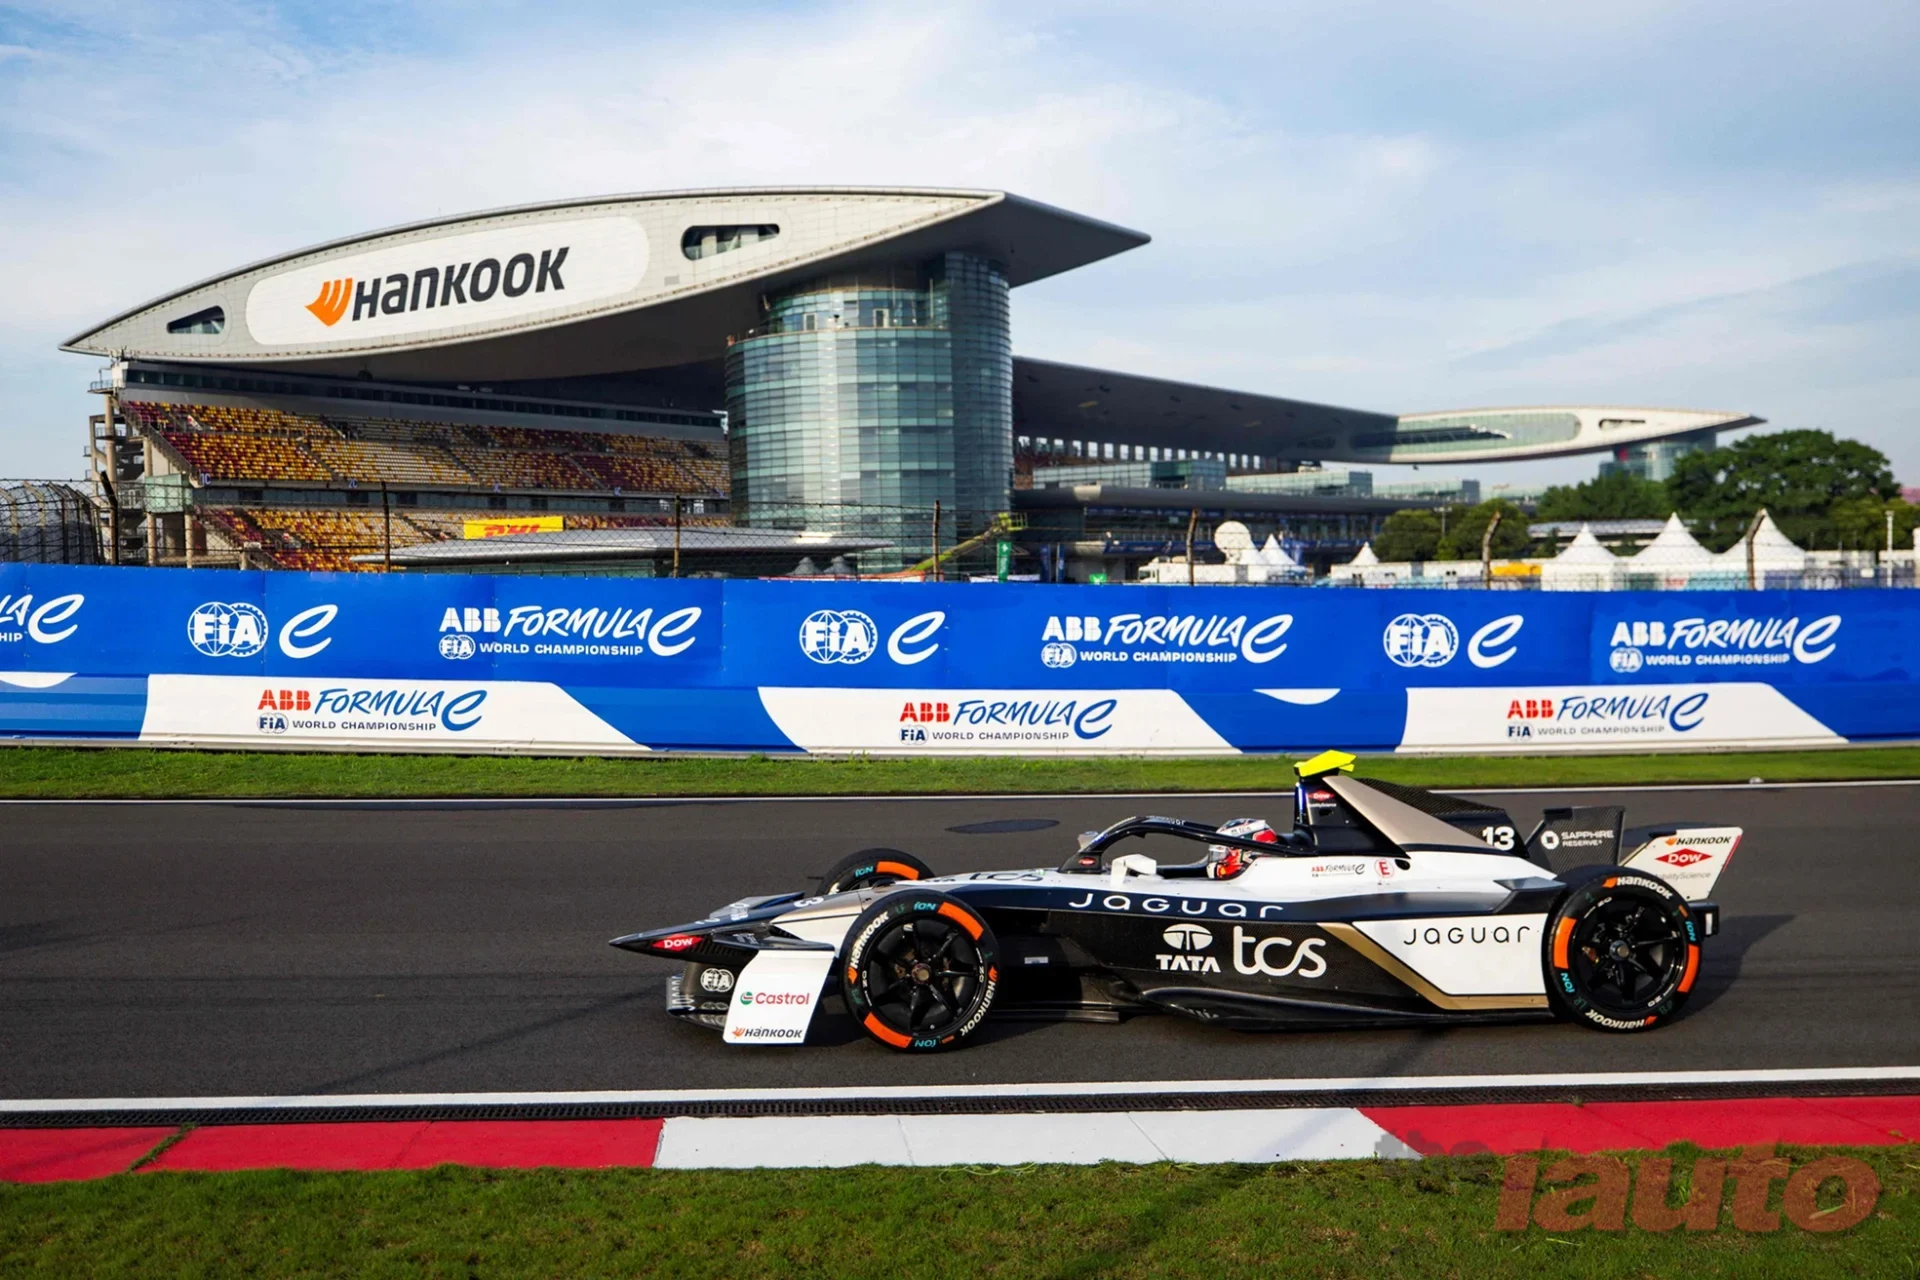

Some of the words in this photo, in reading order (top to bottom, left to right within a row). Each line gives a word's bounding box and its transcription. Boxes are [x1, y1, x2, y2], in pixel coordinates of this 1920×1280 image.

[439, 607, 501, 633] ABB
[503, 605, 653, 638] FORMULA
[1042, 616, 1101, 642] ABB
[1105, 614, 1242, 647] FORMULA
[1611, 621, 1665, 646] ABB
[1667, 617, 1794, 649] FORMULA
[480, 643, 530, 655] WORLD
[534, 644, 643, 656] CHAMPIONSHIP
[1080, 651, 1128, 662] WORLD
[1133, 651, 1237, 663] CHAMPIONSHIP
[1645, 654, 1691, 666] WORLD
[1695, 653, 1790, 665] CHAMPIONSHIP
[258, 690, 311, 711] ABB
[314, 687, 444, 717] FORMULA
[1507, 699, 1553, 718] ABB
[1557, 696, 1668, 722] FORMULA
[900, 702, 950, 722] ABB
[953, 700, 1073, 726] FORMULA
[292, 720, 336, 730] WORLD
[341, 721, 436, 731] CHAMPIONSHIP
[1538, 727, 1577, 736] WORLD
[1581, 725, 1664, 735] CHAMPIONSHIP
[932, 731, 975, 740] WORLD
[979, 731, 1069, 740] CHAMPIONSHIP
[1482, 826, 1515, 851] 13
[1561, 830, 1614, 841] SAPPHIRE
[1379, 861, 1390, 876] E
[1155, 954, 1221, 973] TATA
[756, 992, 810, 1006] Castrol
